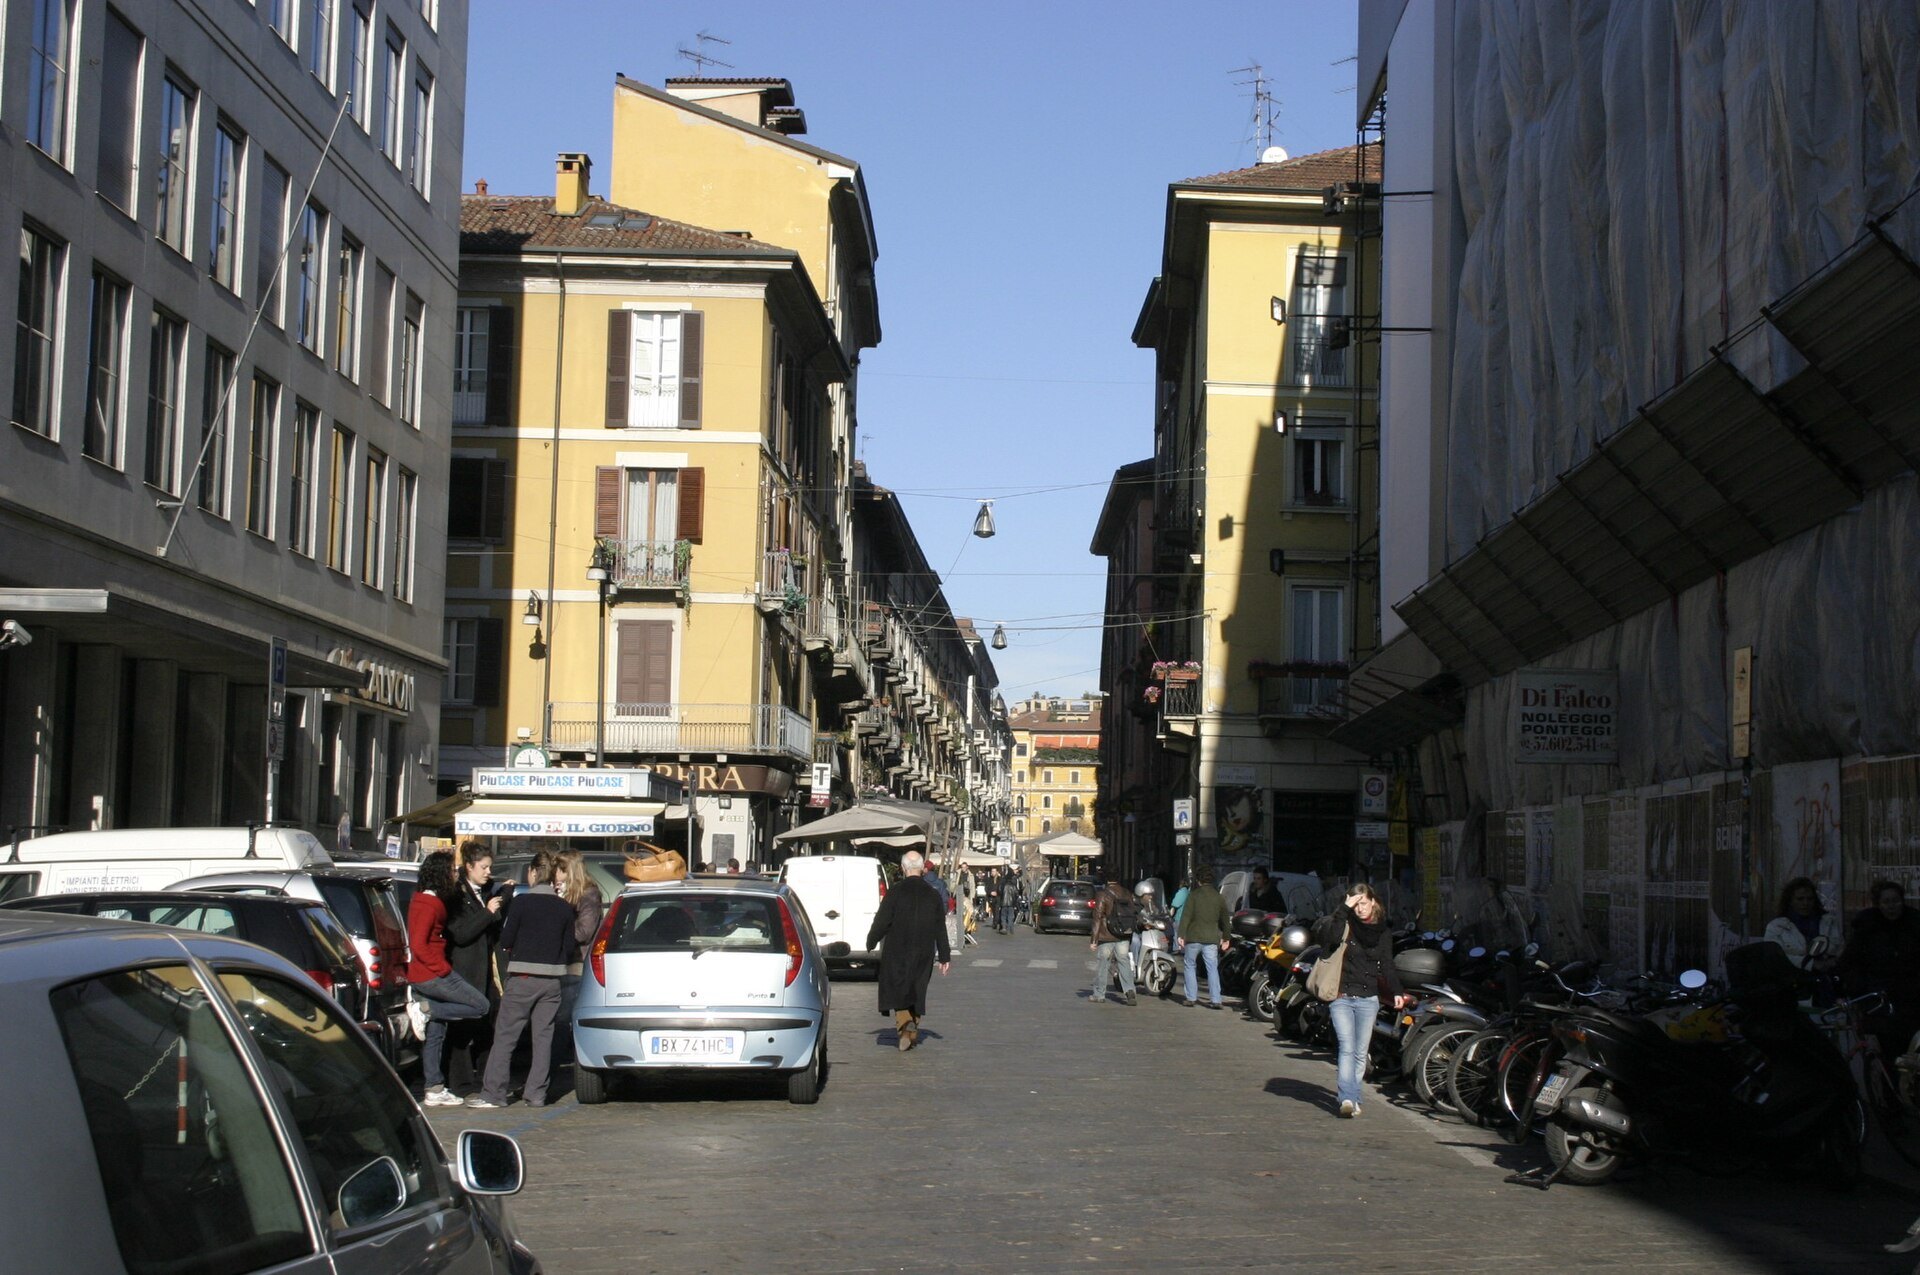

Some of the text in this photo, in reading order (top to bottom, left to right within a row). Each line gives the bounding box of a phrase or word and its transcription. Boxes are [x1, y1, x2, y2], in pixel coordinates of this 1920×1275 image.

[1522, 687, 1612, 710] Di Falco
[1521, 713, 1612, 724] NOLEGGIO
[1521, 724, 1612, 736] PONTEGGI
[638, 763, 745, 790] PERA
[458, 821, 475, 831] IL
[479, 821, 542, 832] GIORNO
[567, 823, 585, 832] IL
[588, 823, 652, 833] GIORNO
[66, 876, 139, 885] IMPIANTI ELETTRICI
[661, 1039, 725, 1053] BX 741HC
